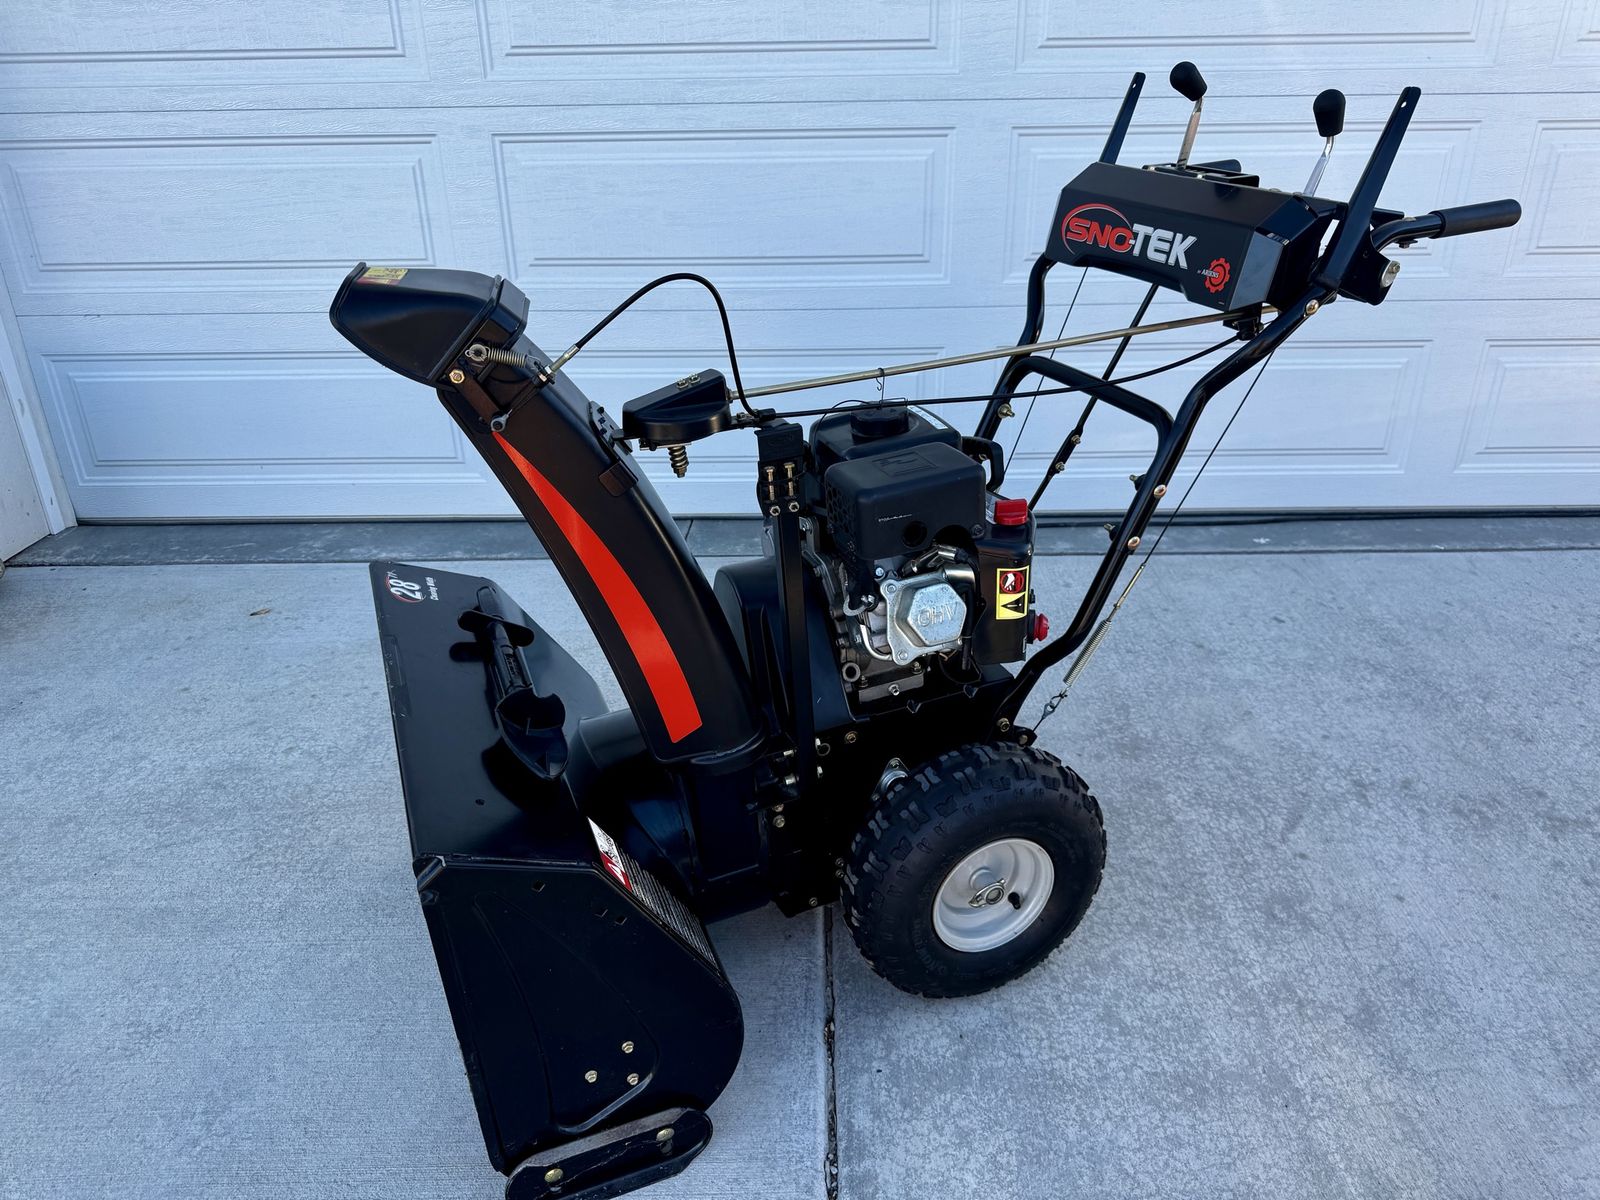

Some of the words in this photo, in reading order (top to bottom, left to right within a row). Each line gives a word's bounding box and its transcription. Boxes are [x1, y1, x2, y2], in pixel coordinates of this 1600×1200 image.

[1066, 217, 1197, 269] SNO-TEK
[389, 578, 422, 600] 28
[917, 602, 959, 628] OHV
